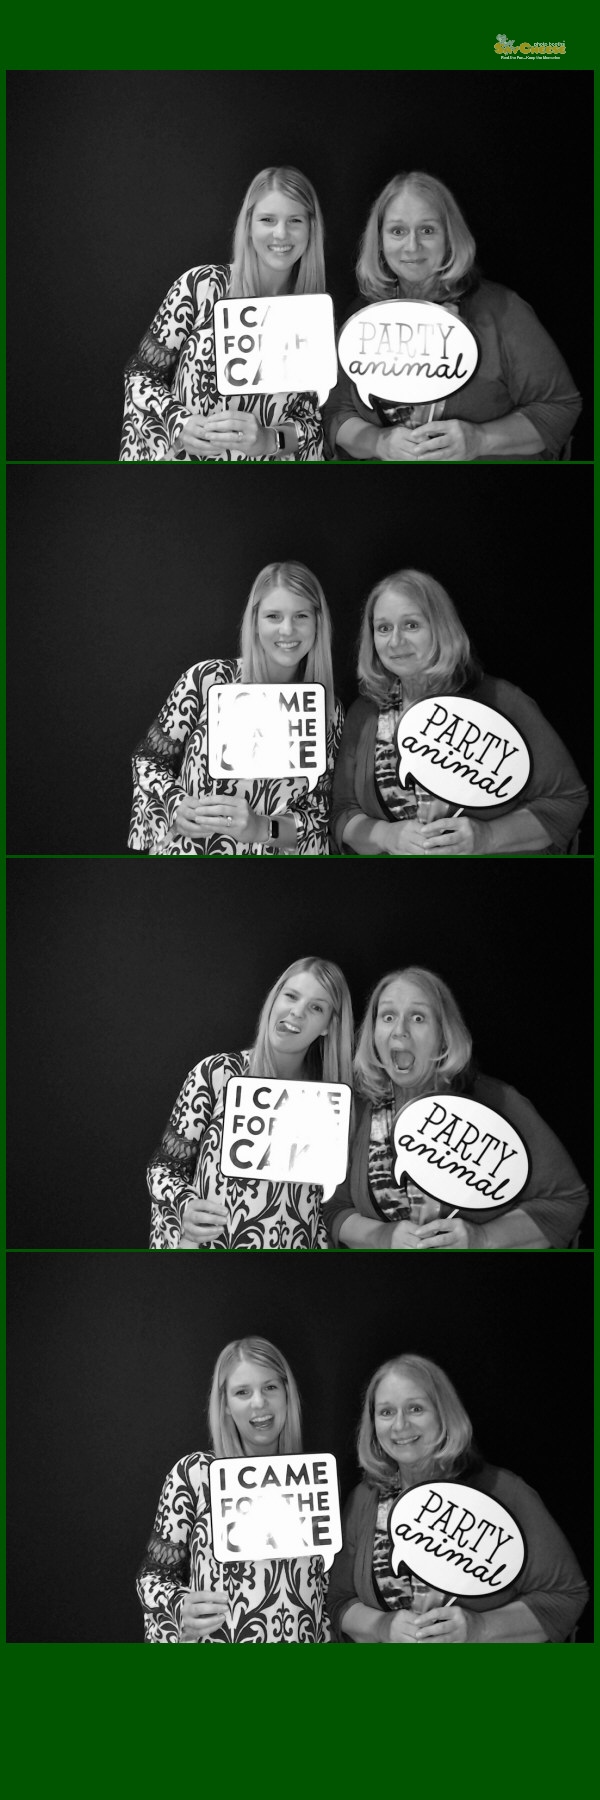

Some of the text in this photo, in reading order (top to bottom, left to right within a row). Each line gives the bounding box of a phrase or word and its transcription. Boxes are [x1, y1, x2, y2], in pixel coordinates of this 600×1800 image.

[223, 307, 229, 329] I
[224, 334, 263, 354] FO
[358, 321, 456, 360] PARTY
[349, 352, 468, 380] animal
[419, 703, 519, 776] PARTY
[401, 736, 513, 798] animal
[235, 1085, 342, 1115] I CAE
[416, 1102, 518, 1178] PARTY
[398, 1134, 511, 1201] animal
[219, 1461, 328, 1491] I CAME
[220, 1496, 255, 1518] FO
[413, 1489, 514, 1565] PARTY
[395, 1524, 507, 1587] animal
